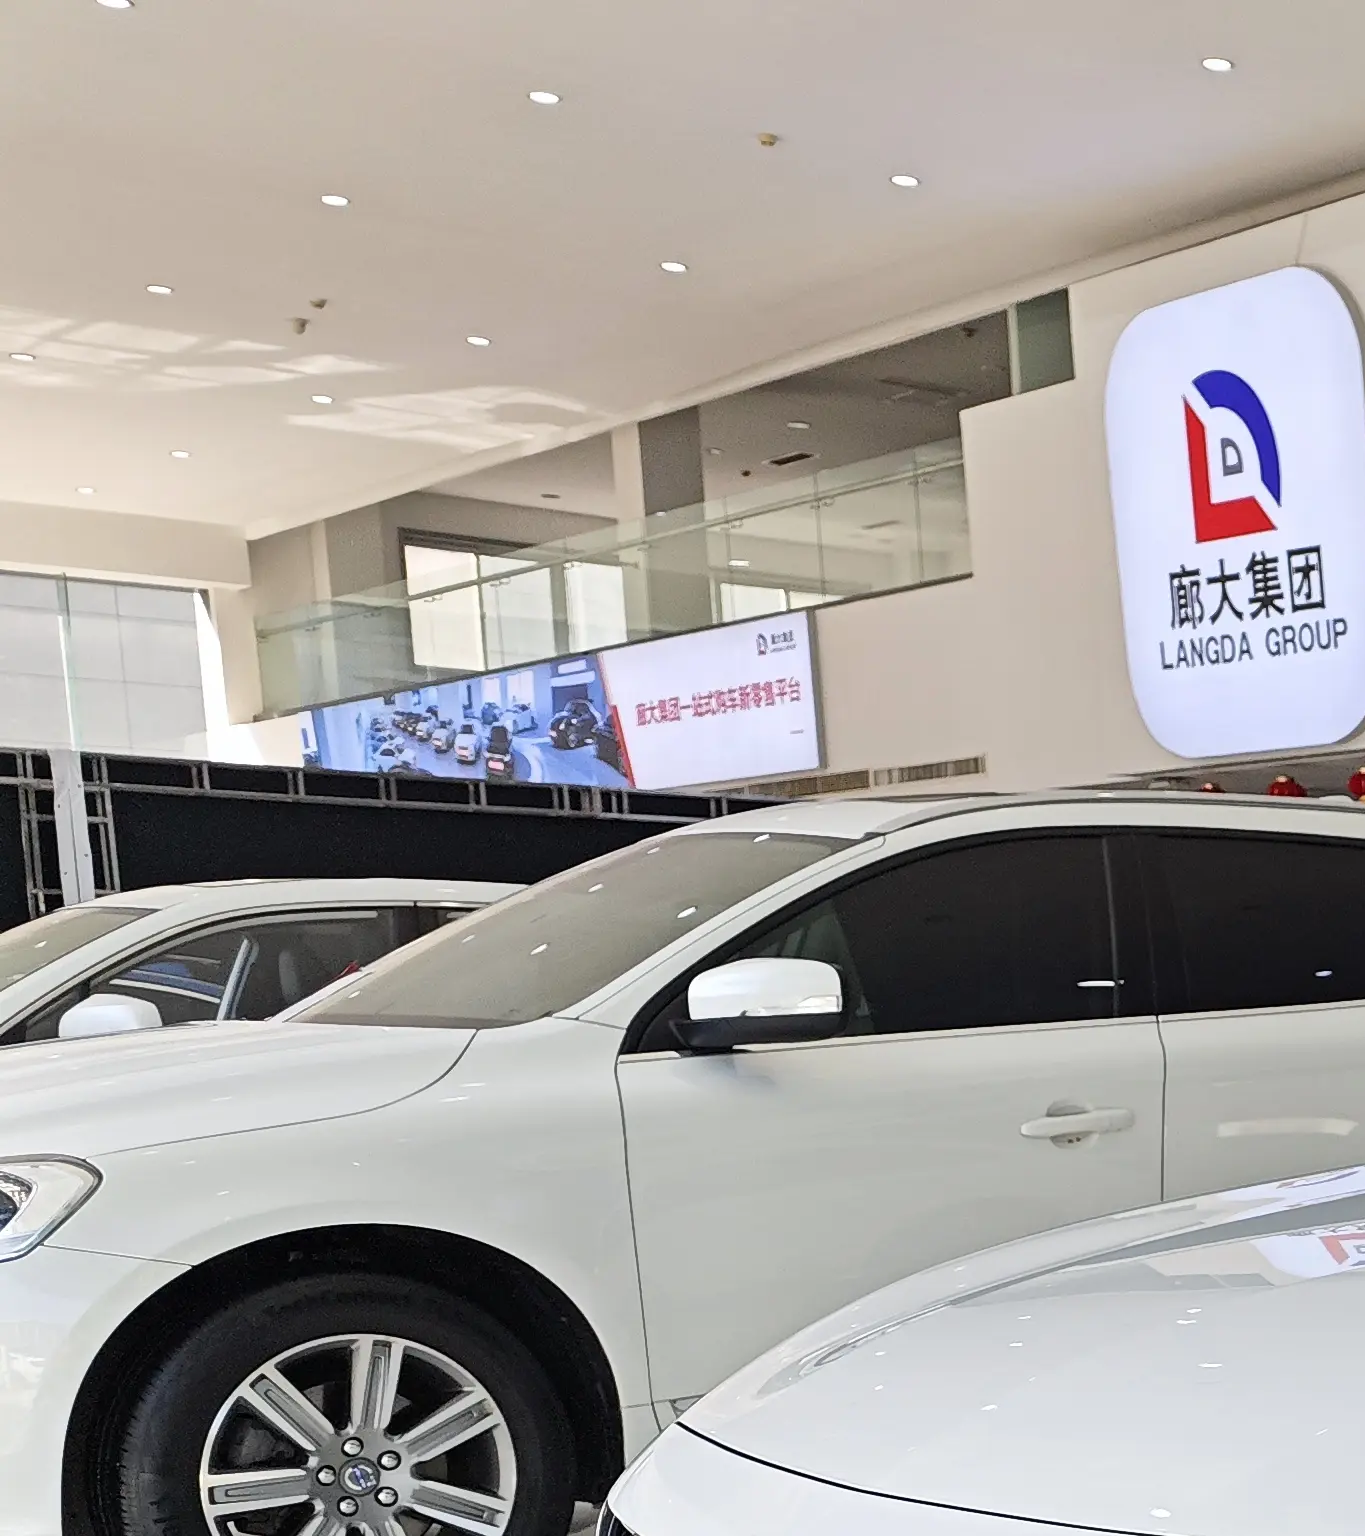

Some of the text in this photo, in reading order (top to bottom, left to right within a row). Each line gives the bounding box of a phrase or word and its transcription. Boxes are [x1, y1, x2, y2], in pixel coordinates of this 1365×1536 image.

[1169, 544, 1327, 630] 廊大集团
[1159, 616, 1348, 671] LANGDA GROUP
